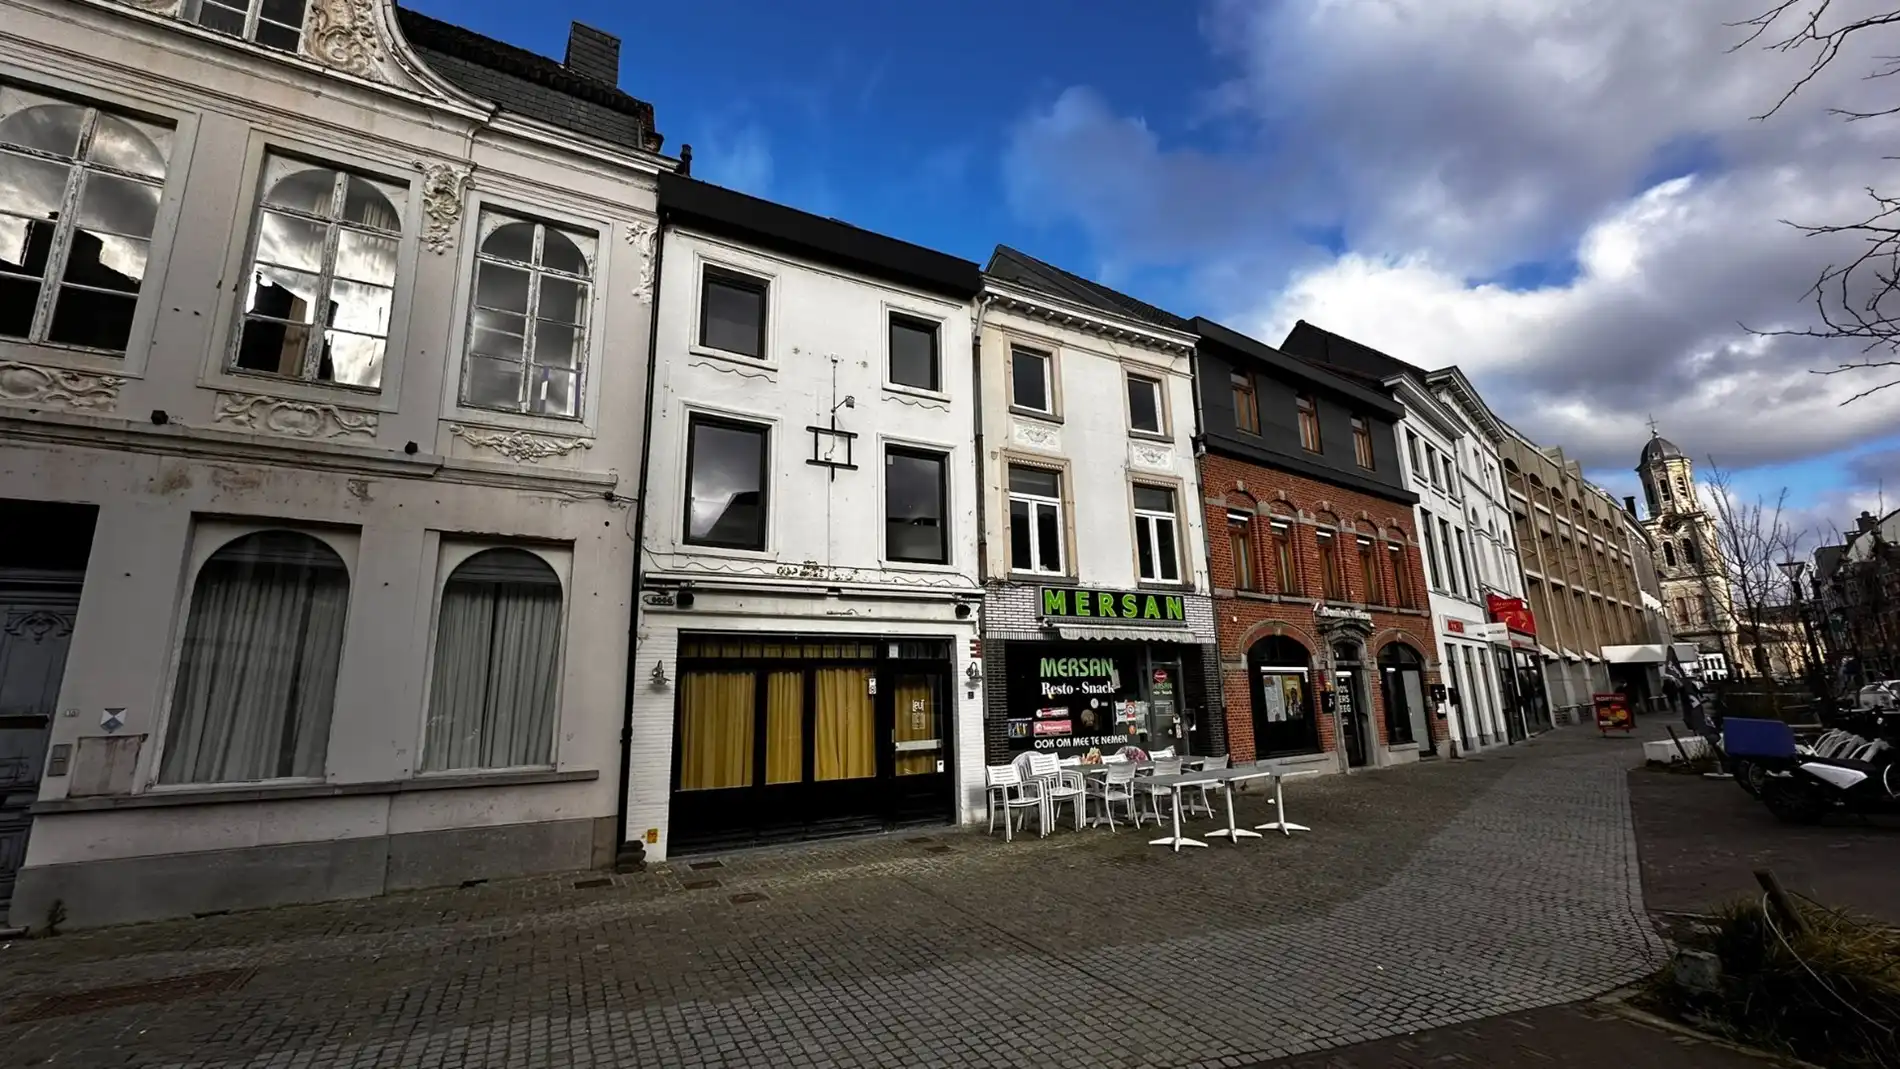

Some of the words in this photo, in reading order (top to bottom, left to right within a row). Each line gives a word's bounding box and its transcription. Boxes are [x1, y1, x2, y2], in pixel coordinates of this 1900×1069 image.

[1044, 589, 1183, 620] MERSAN
[1040, 657, 1113, 678] MERSAN
[1041, 681, 1074, 696] Resto
[1082, 680, 1115, 694] Snack
[1034, 739, 1054, 749] OOK
[1056, 738, 1071, 747] OM
[1073, 737, 1089, 746] MEE
[1091, 736, 1099, 745] TE
[1101, 735, 1128, 744] NEMEN
